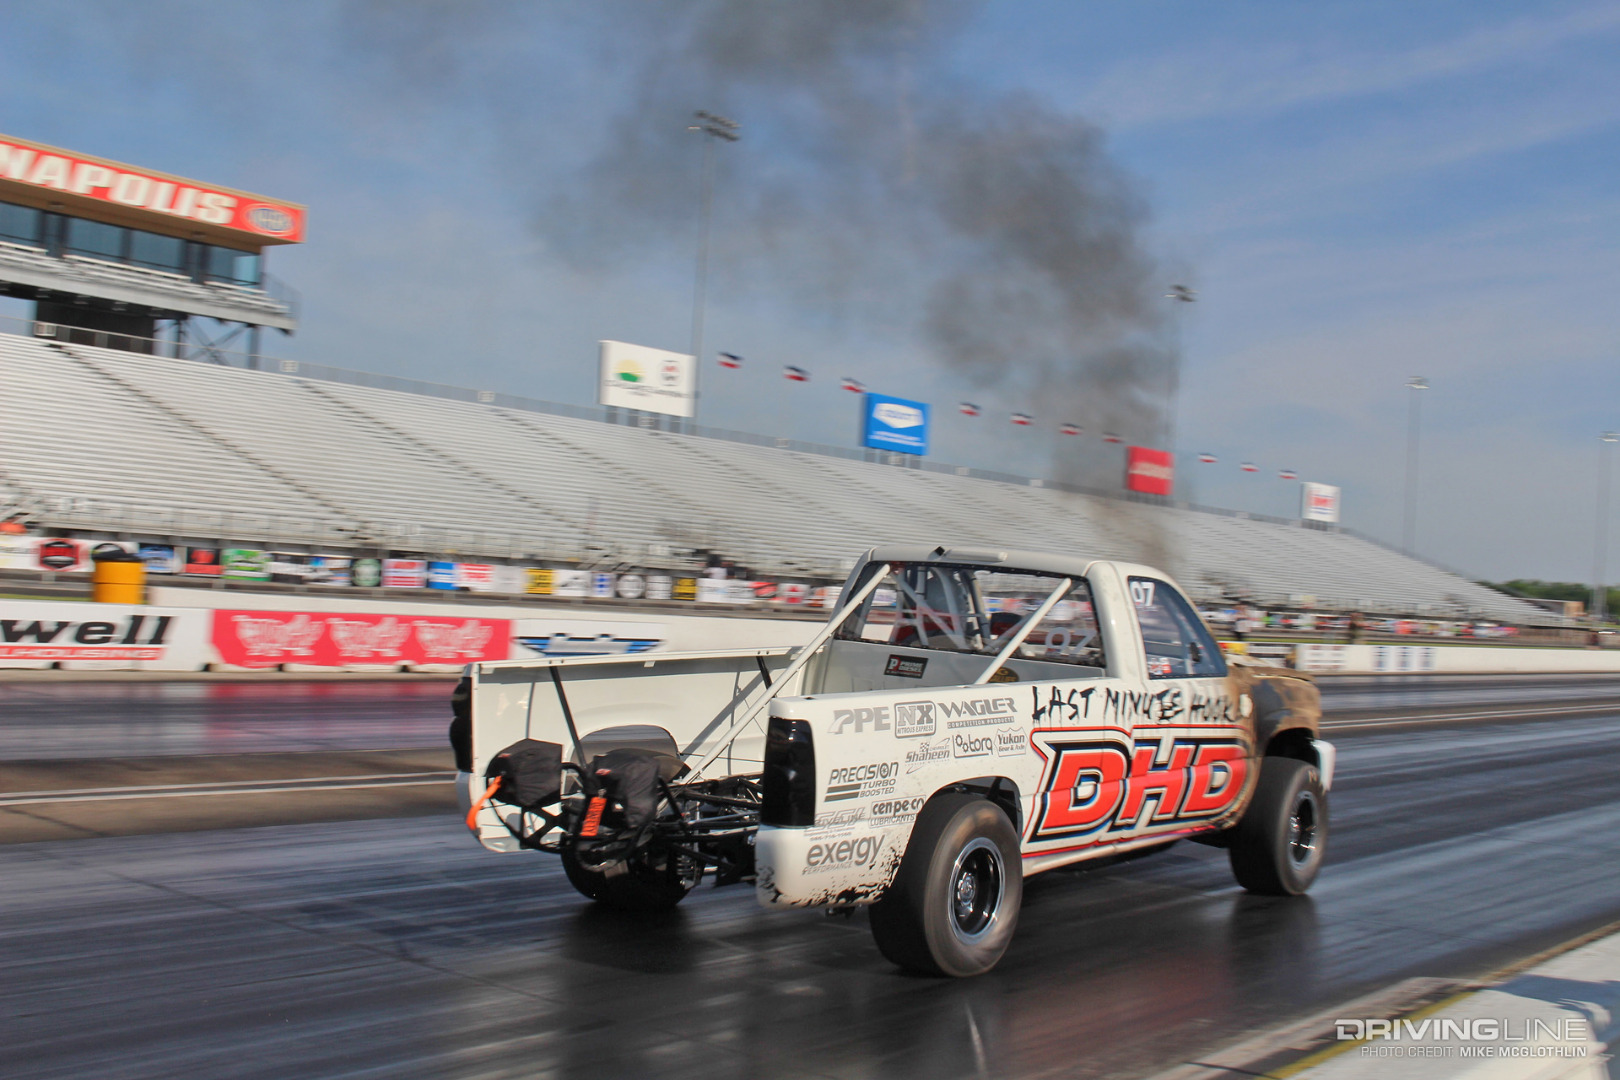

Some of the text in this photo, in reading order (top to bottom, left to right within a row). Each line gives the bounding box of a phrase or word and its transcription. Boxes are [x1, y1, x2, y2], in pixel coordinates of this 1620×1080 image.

[1130, 581, 1155, 606] 07
[1045, 627, 1097, 654] 07
[938, 697, 1018, 718] WAGLER
[1032, 686, 1096, 720] LAST
[1103, 688, 1184, 721] MINUTE
[828, 706, 891, 734] PPE
[897, 704, 934, 727] NX
[948, 716, 1014, 728] COMPETITION PRODUCTS
[998, 733, 1025, 745] Yukon
[905, 748, 950, 762] Shaheen
[829, 762, 898, 785] PRECISION
[863, 779, 896, 789] TURBO
[860, 787, 894, 798] BOOSTED
[1027, 737, 1249, 843] DHD
[871, 814, 915, 827] LUBRICANTS
[807, 835, 885, 867] exergy
[802, 861, 853, 875] PERFORMANCE
